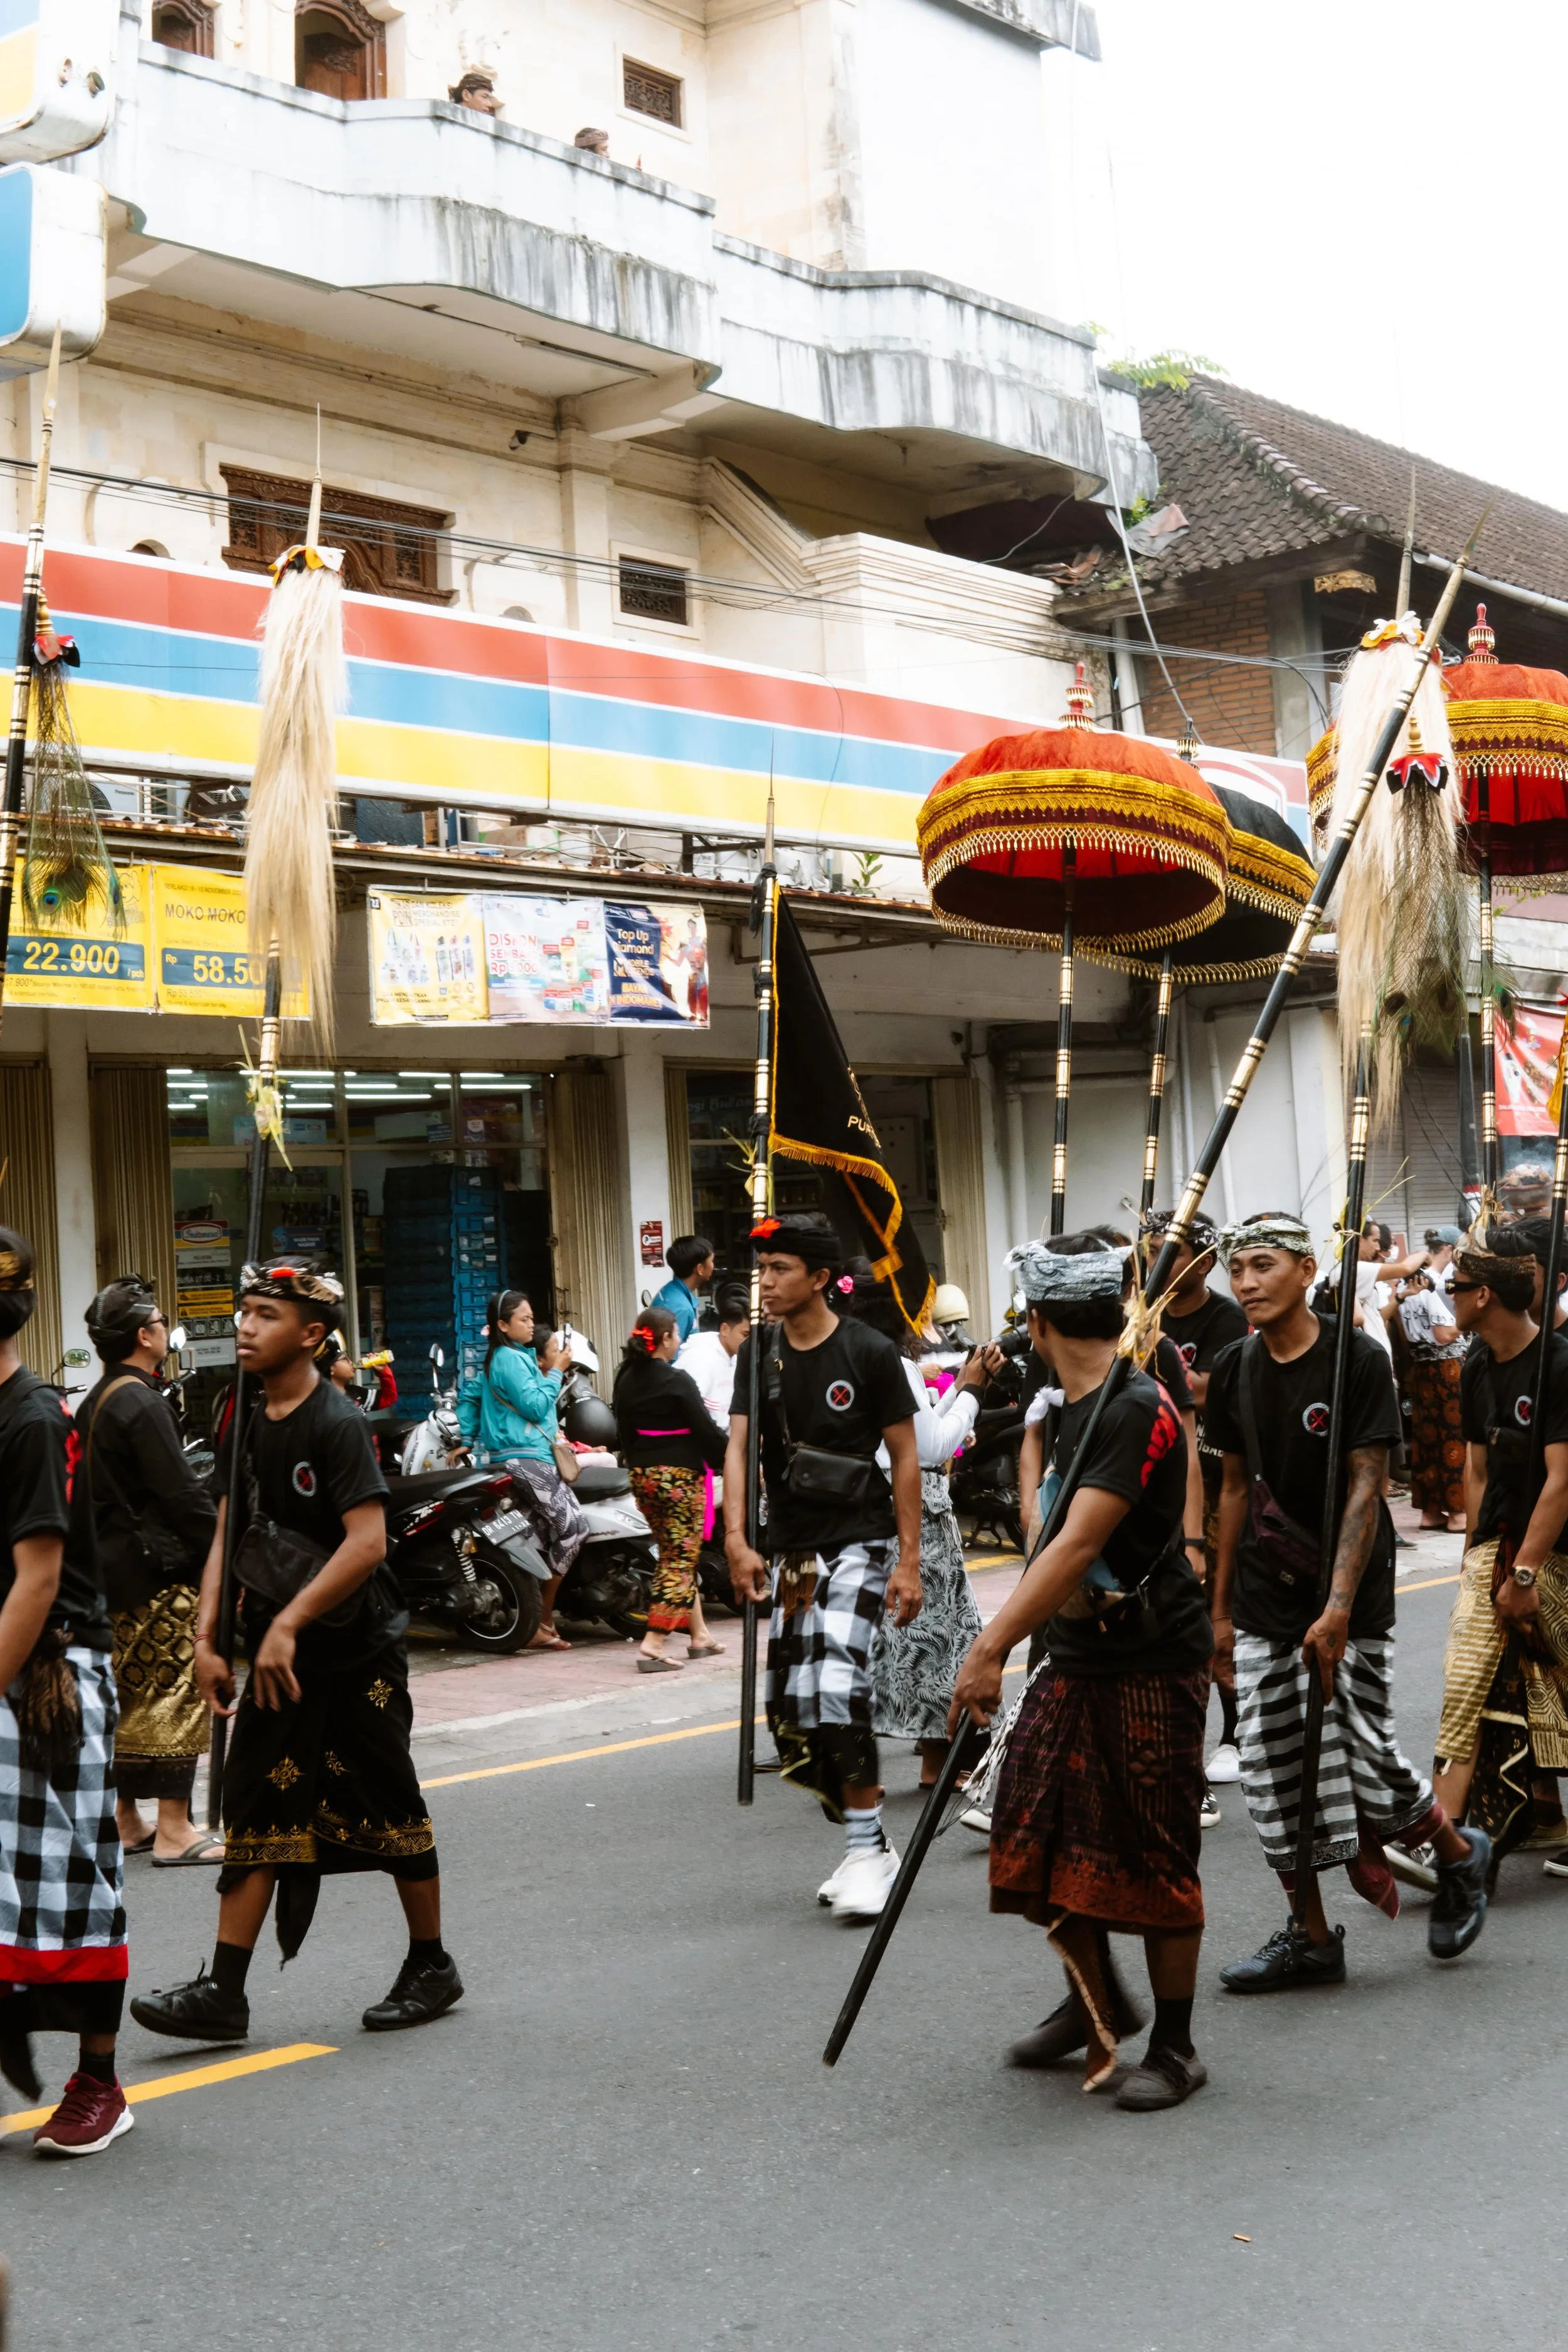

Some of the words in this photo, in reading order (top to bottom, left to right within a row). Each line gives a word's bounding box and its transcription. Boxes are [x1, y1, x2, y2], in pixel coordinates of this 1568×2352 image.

[165, 904, 204, 920] MOKO
[207, 908, 246, 924] MOKO
[617, 928, 635, 943] Top
[636, 930, 650, 944] Up
[23, 941, 120, 974] 22.900
[490, 950, 538, 959] SEMBAO
[165, 954, 177, 966] Rp
[193, 955, 263, 985] 58.50
[490, 963, 507, 975] Rp
[167, 988, 177, 999] Rp
